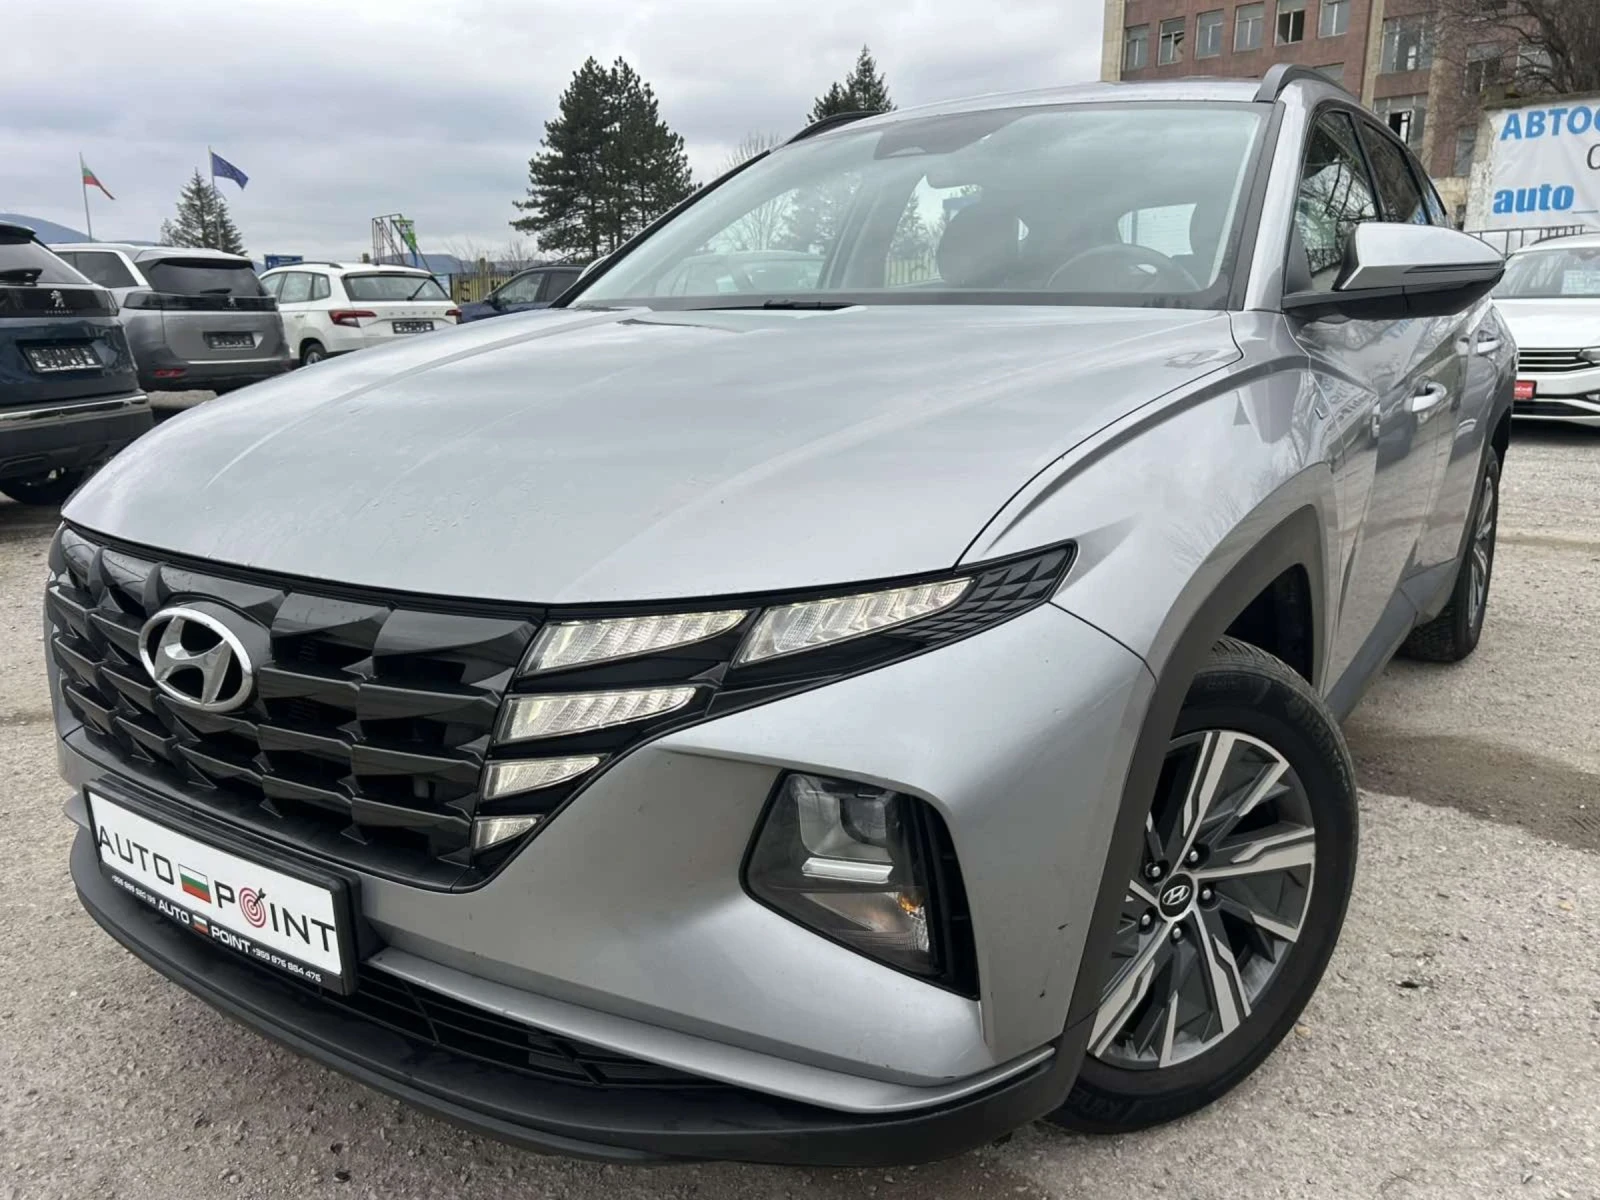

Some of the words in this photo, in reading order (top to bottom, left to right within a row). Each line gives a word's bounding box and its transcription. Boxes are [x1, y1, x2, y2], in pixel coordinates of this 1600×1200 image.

[1492, 183, 1575, 214] auto
[99, 825, 174, 885] AUTO
[158, 899, 190, 924] AUTO
[210, 925, 251, 953] POINT
